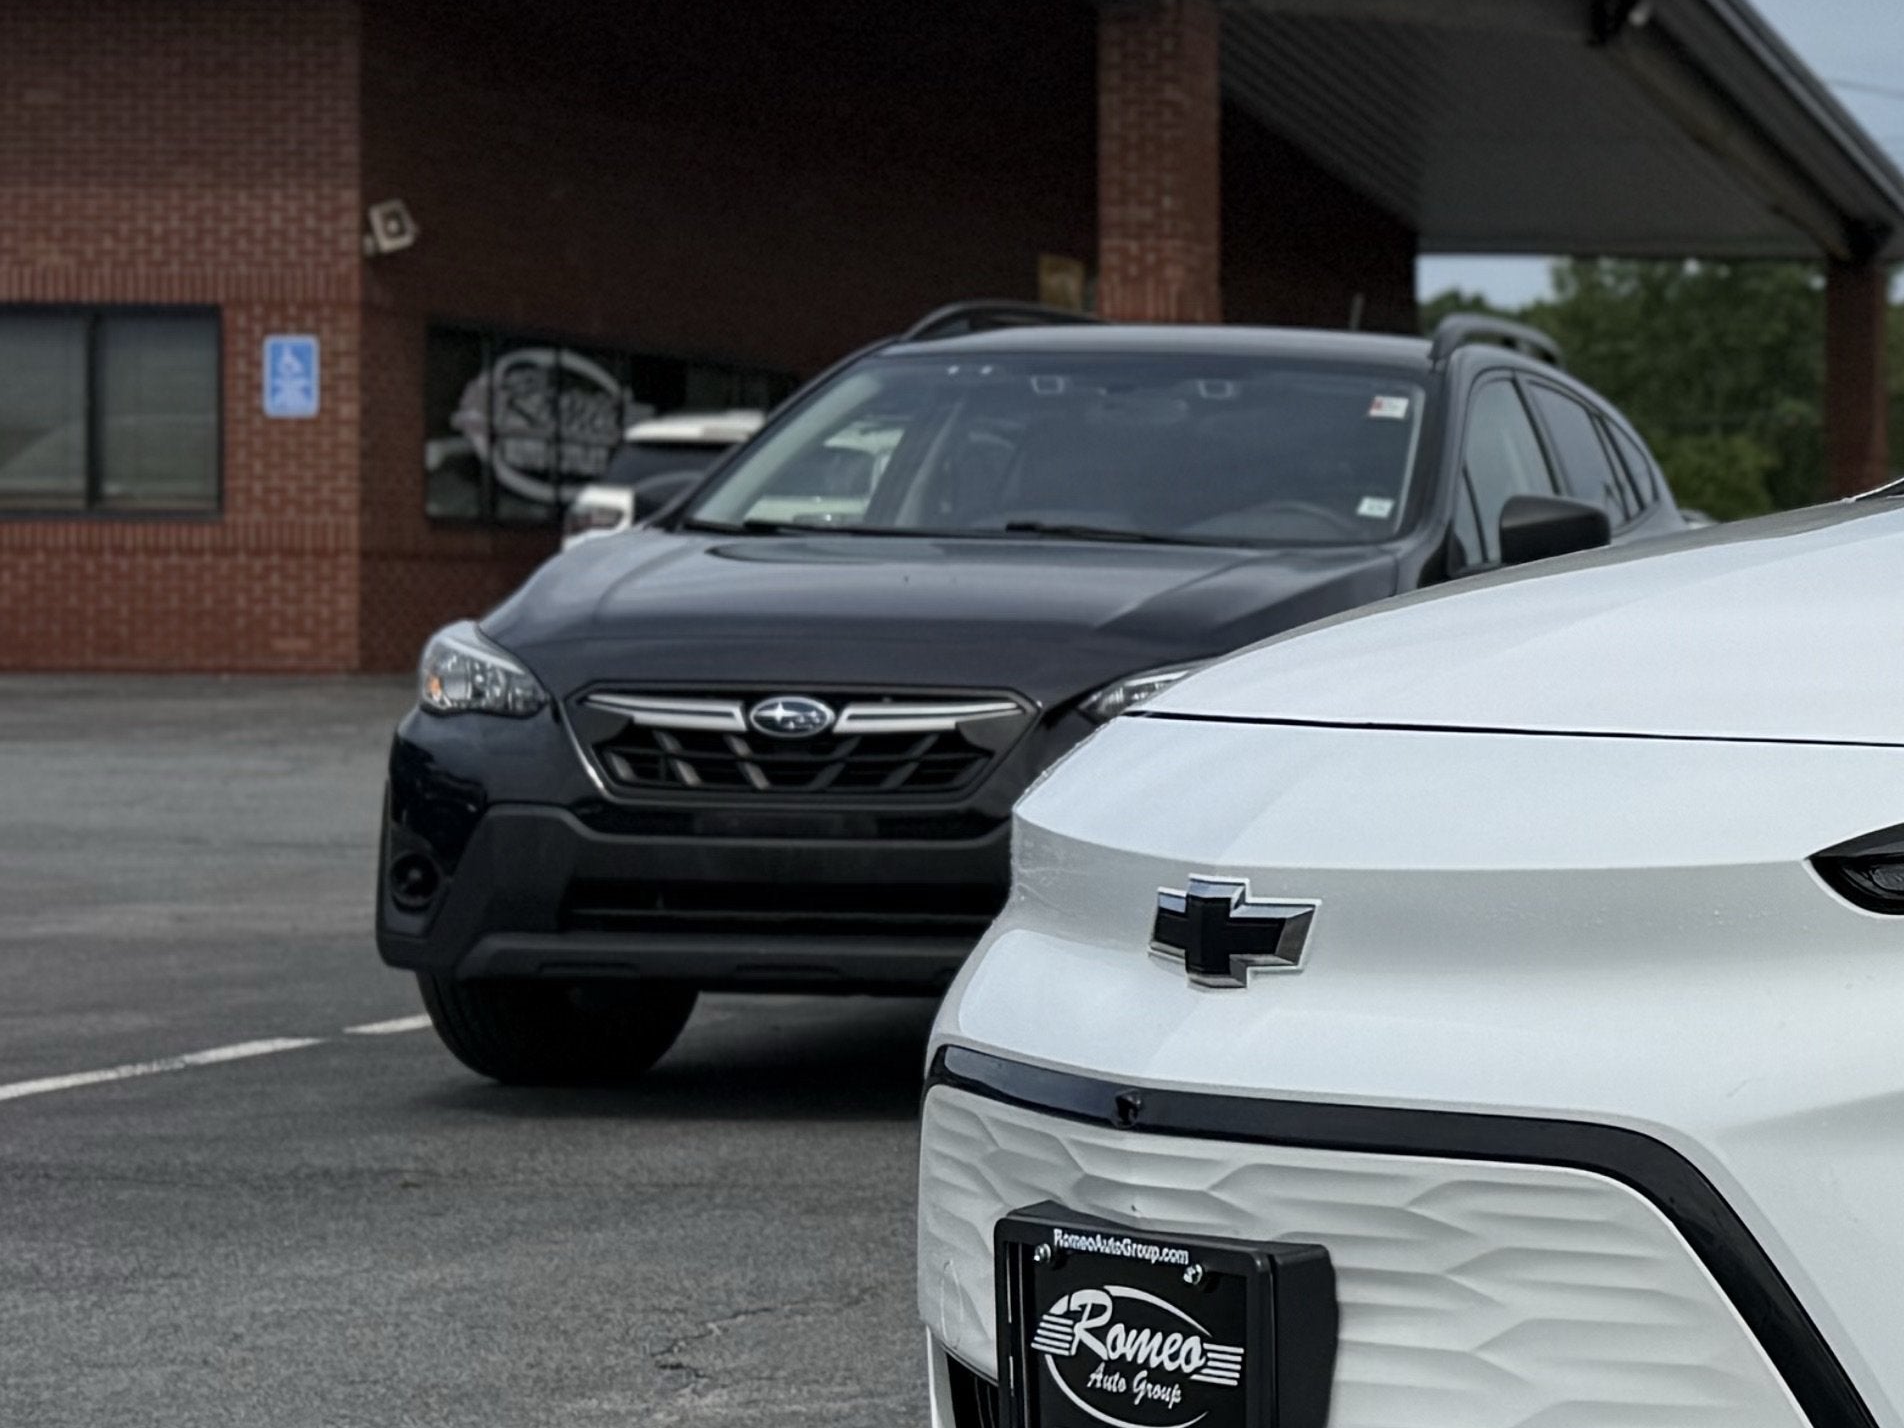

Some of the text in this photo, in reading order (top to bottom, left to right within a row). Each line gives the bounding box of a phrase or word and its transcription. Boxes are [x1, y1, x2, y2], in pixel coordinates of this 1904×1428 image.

[1053, 1227, 1190, 1266] RomeoAutoGroup.com
[1070, 1288, 1206, 1374] Romeo
[1086, 1363, 1182, 1410] Auto Group
